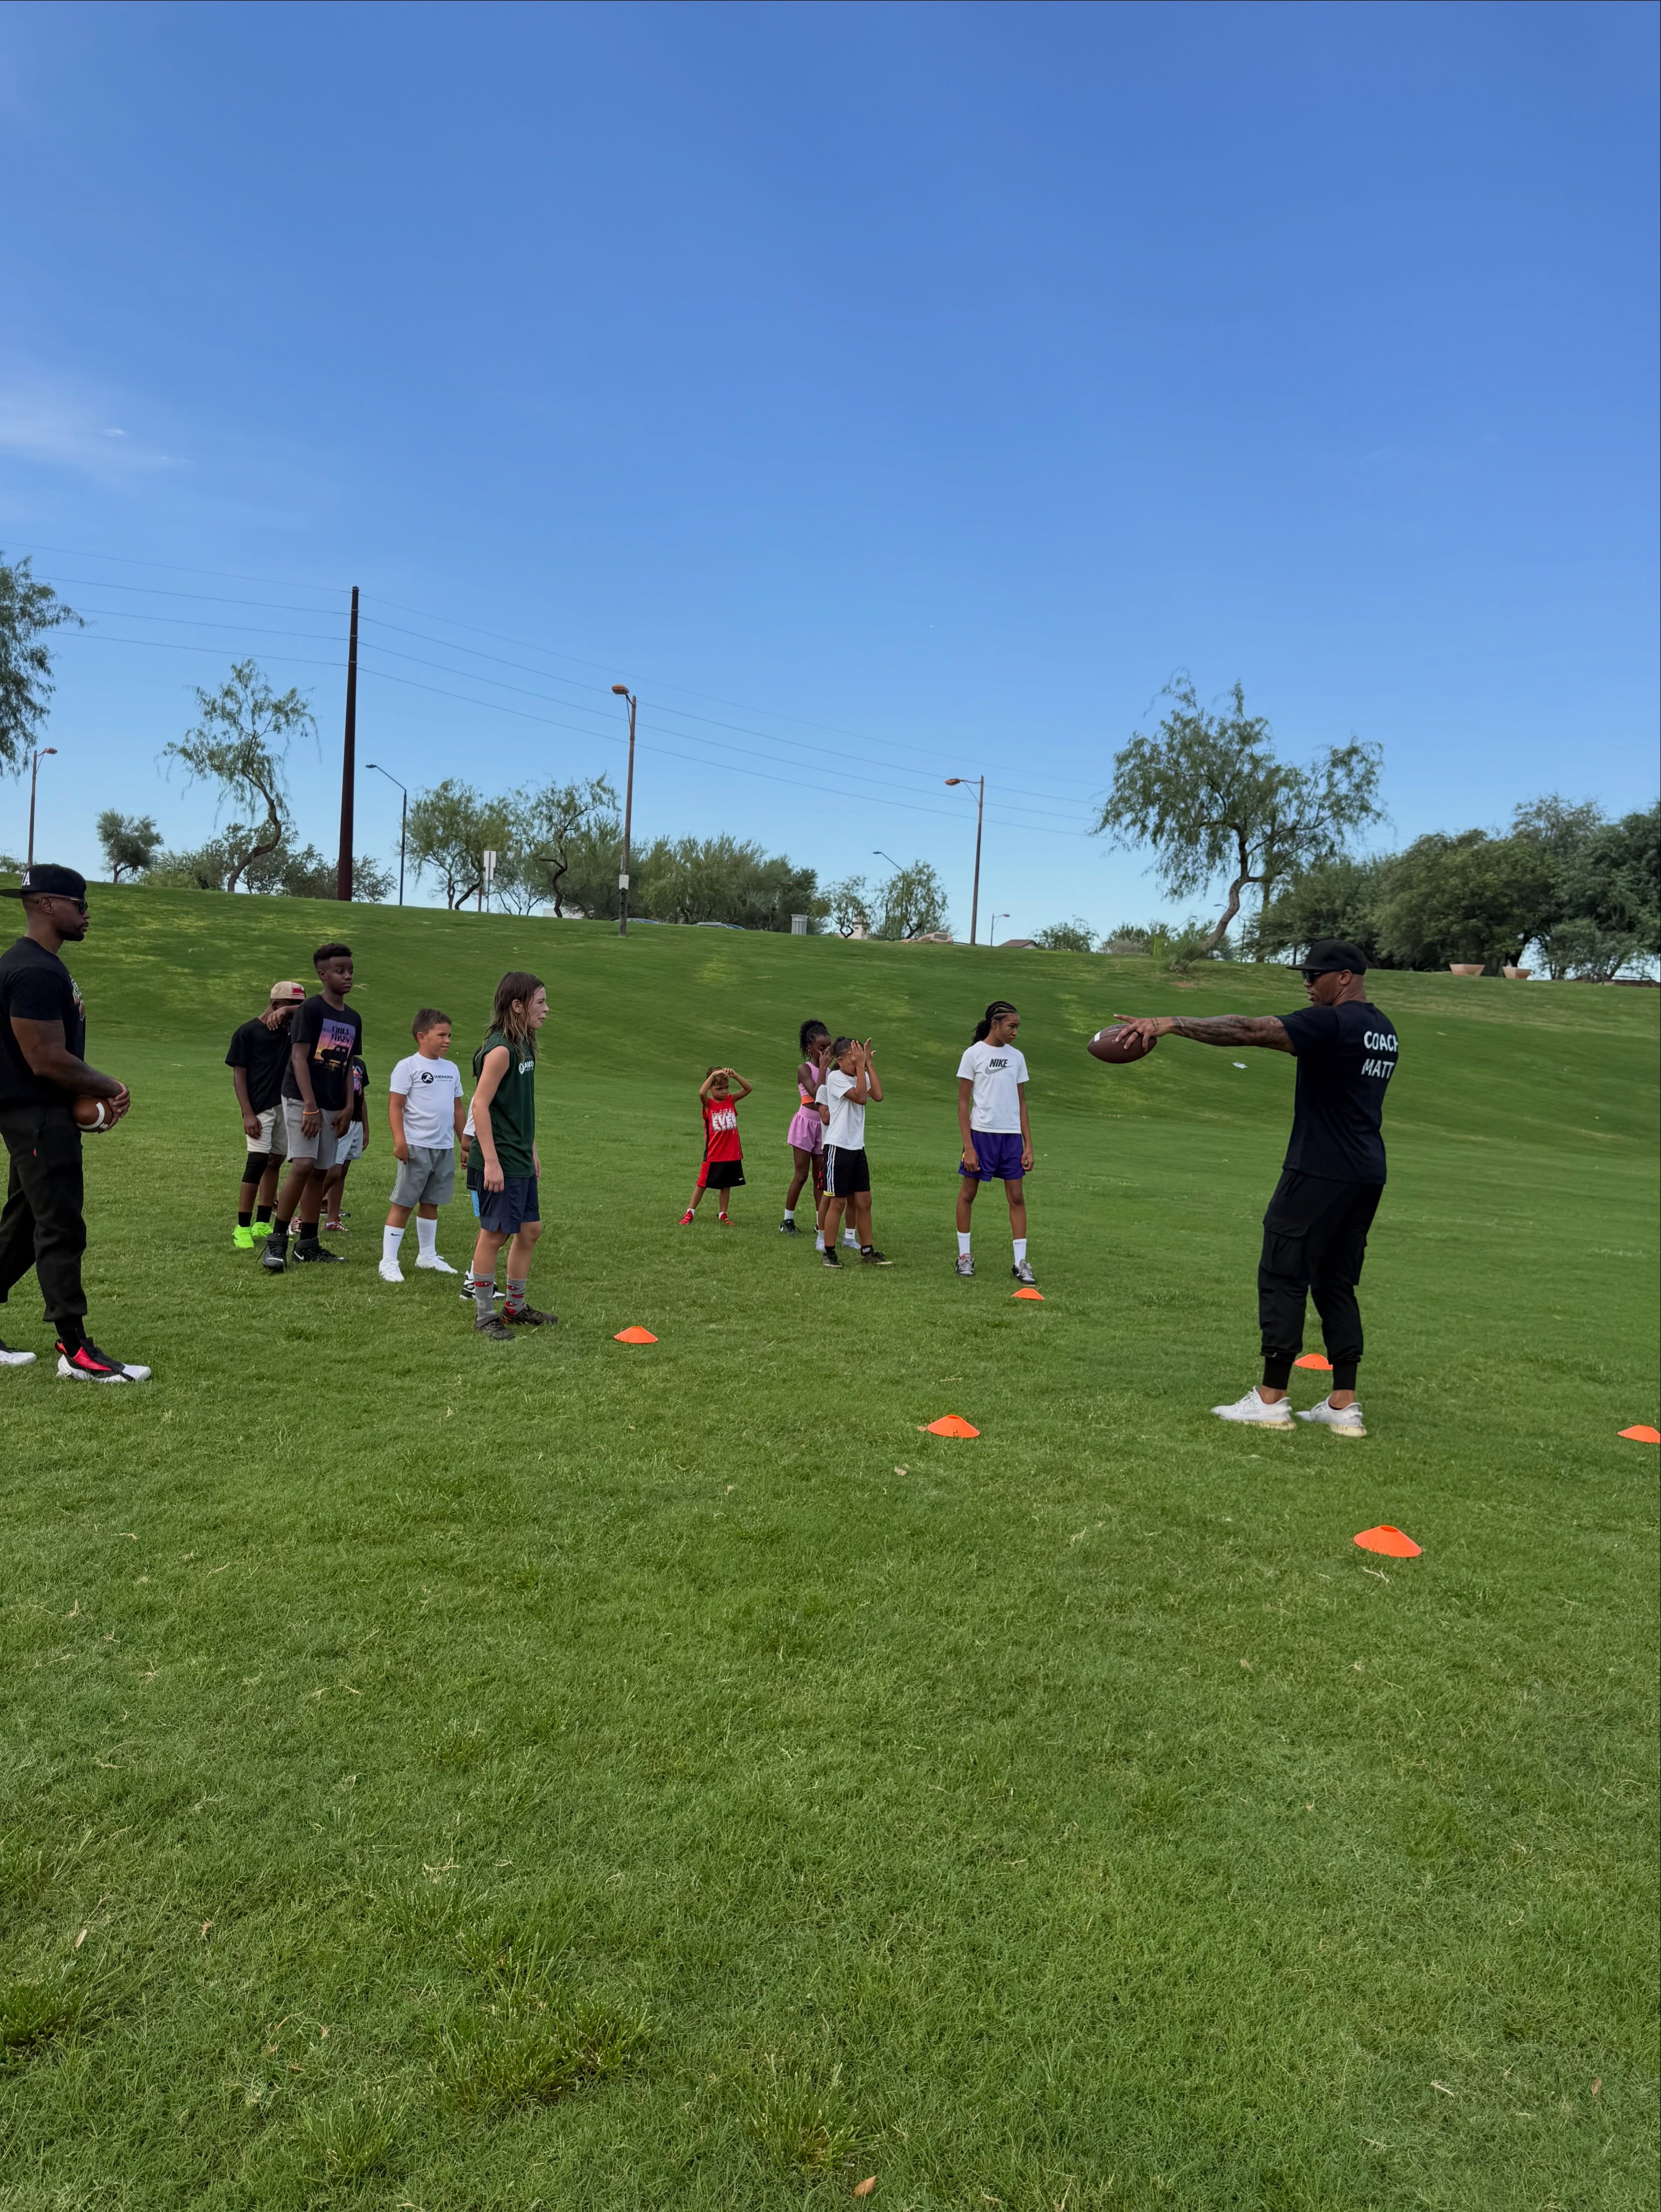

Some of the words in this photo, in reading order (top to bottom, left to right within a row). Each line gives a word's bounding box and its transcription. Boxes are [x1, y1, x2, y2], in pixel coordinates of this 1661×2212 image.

[332, 1026, 350, 1035] CHILL
[989, 1058, 1008, 1068] NIKE
[1361, 1058, 1395, 1079] MATT
